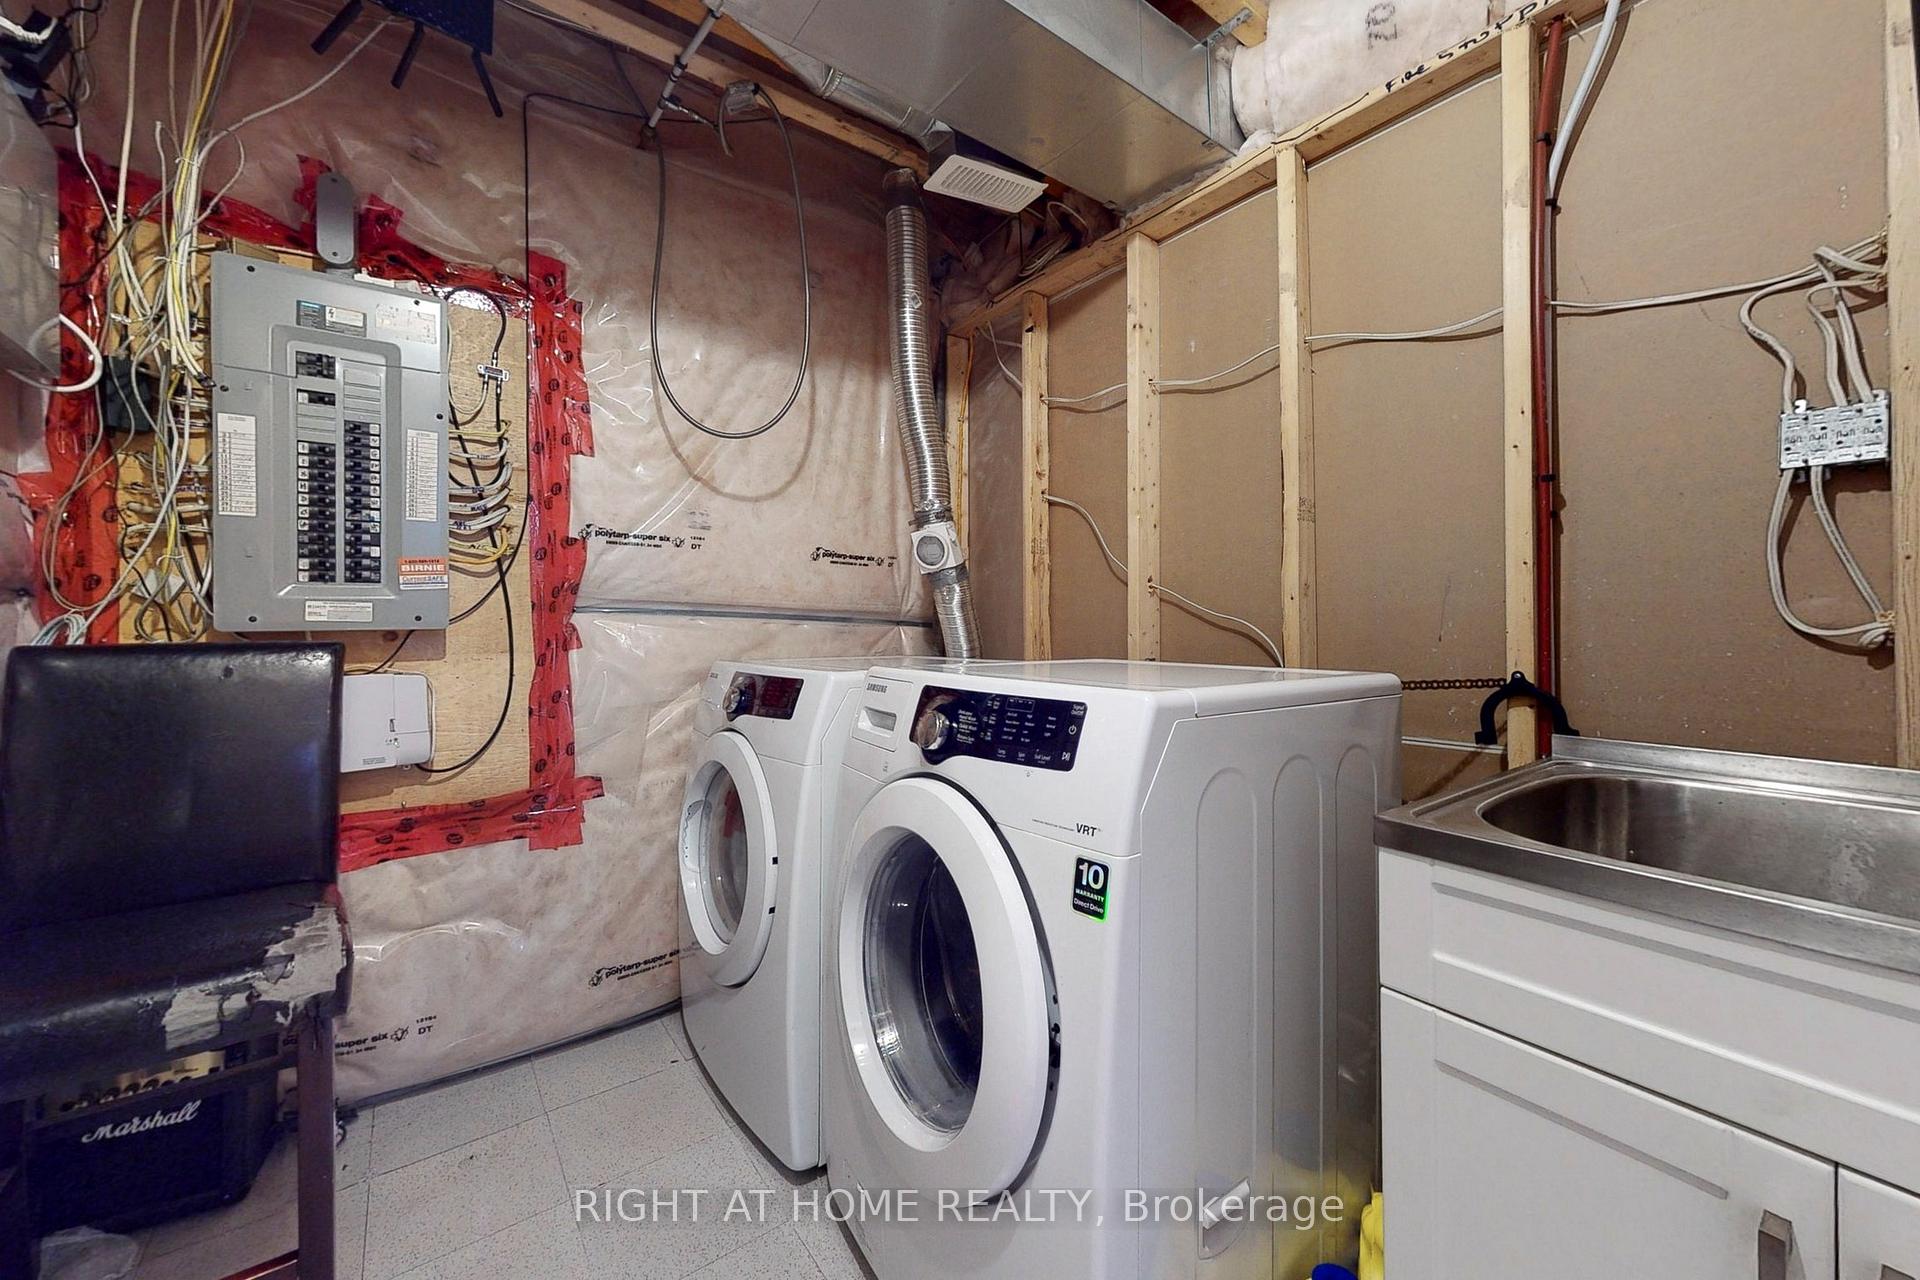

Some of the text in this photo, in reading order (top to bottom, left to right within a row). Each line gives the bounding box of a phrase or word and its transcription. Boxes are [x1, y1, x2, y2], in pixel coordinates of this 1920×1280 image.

[659, 534, 671, 543] six
[401, 564, 445, 572] BIRNIE
[866, 682, 888, 694] SAMSUNG
[1076, 823, 1097, 837] VRT
[1079, 862, 1105, 890] 10
[1075, 888, 1104, 903] WARRANTY
[1073, 897, 1104, 914] Direct Drive
[371, 1031, 388, 1042] six
[418, 1025, 433, 1035] DT
[81, 1099, 202, 1143] Marshall
